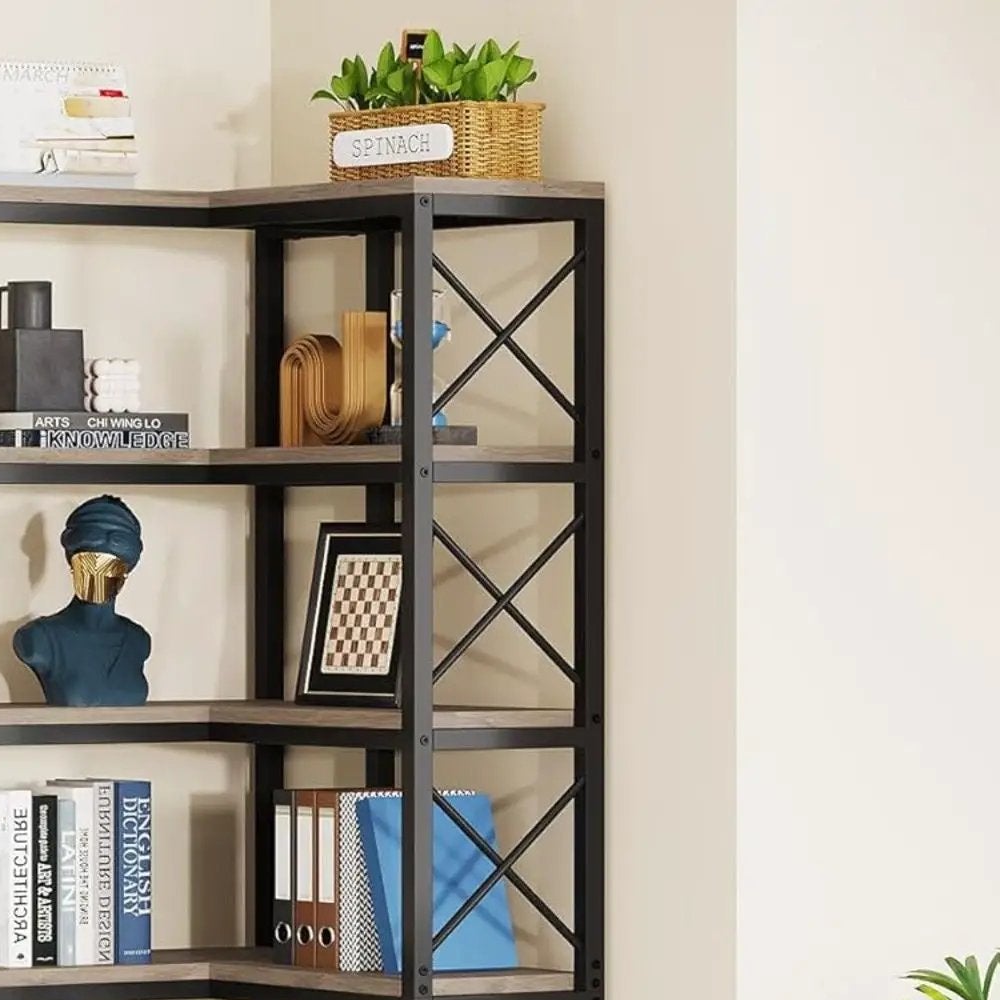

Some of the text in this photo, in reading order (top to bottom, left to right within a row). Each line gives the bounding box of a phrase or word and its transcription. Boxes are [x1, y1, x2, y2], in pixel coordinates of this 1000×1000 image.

[2, 69, 69, 83] MARCH
[352, 133, 430, 158] SPINACH
[35, 416, 162, 429] ARTS CHI WING LO
[122, 797, 139, 918] DICTIONARY
[138, 797, 151, 917] ENGLISH
[37, 862, 52, 885] ART
[37, 885, 52, 897] &
[37, 896, 52, 943] ARTISTS
